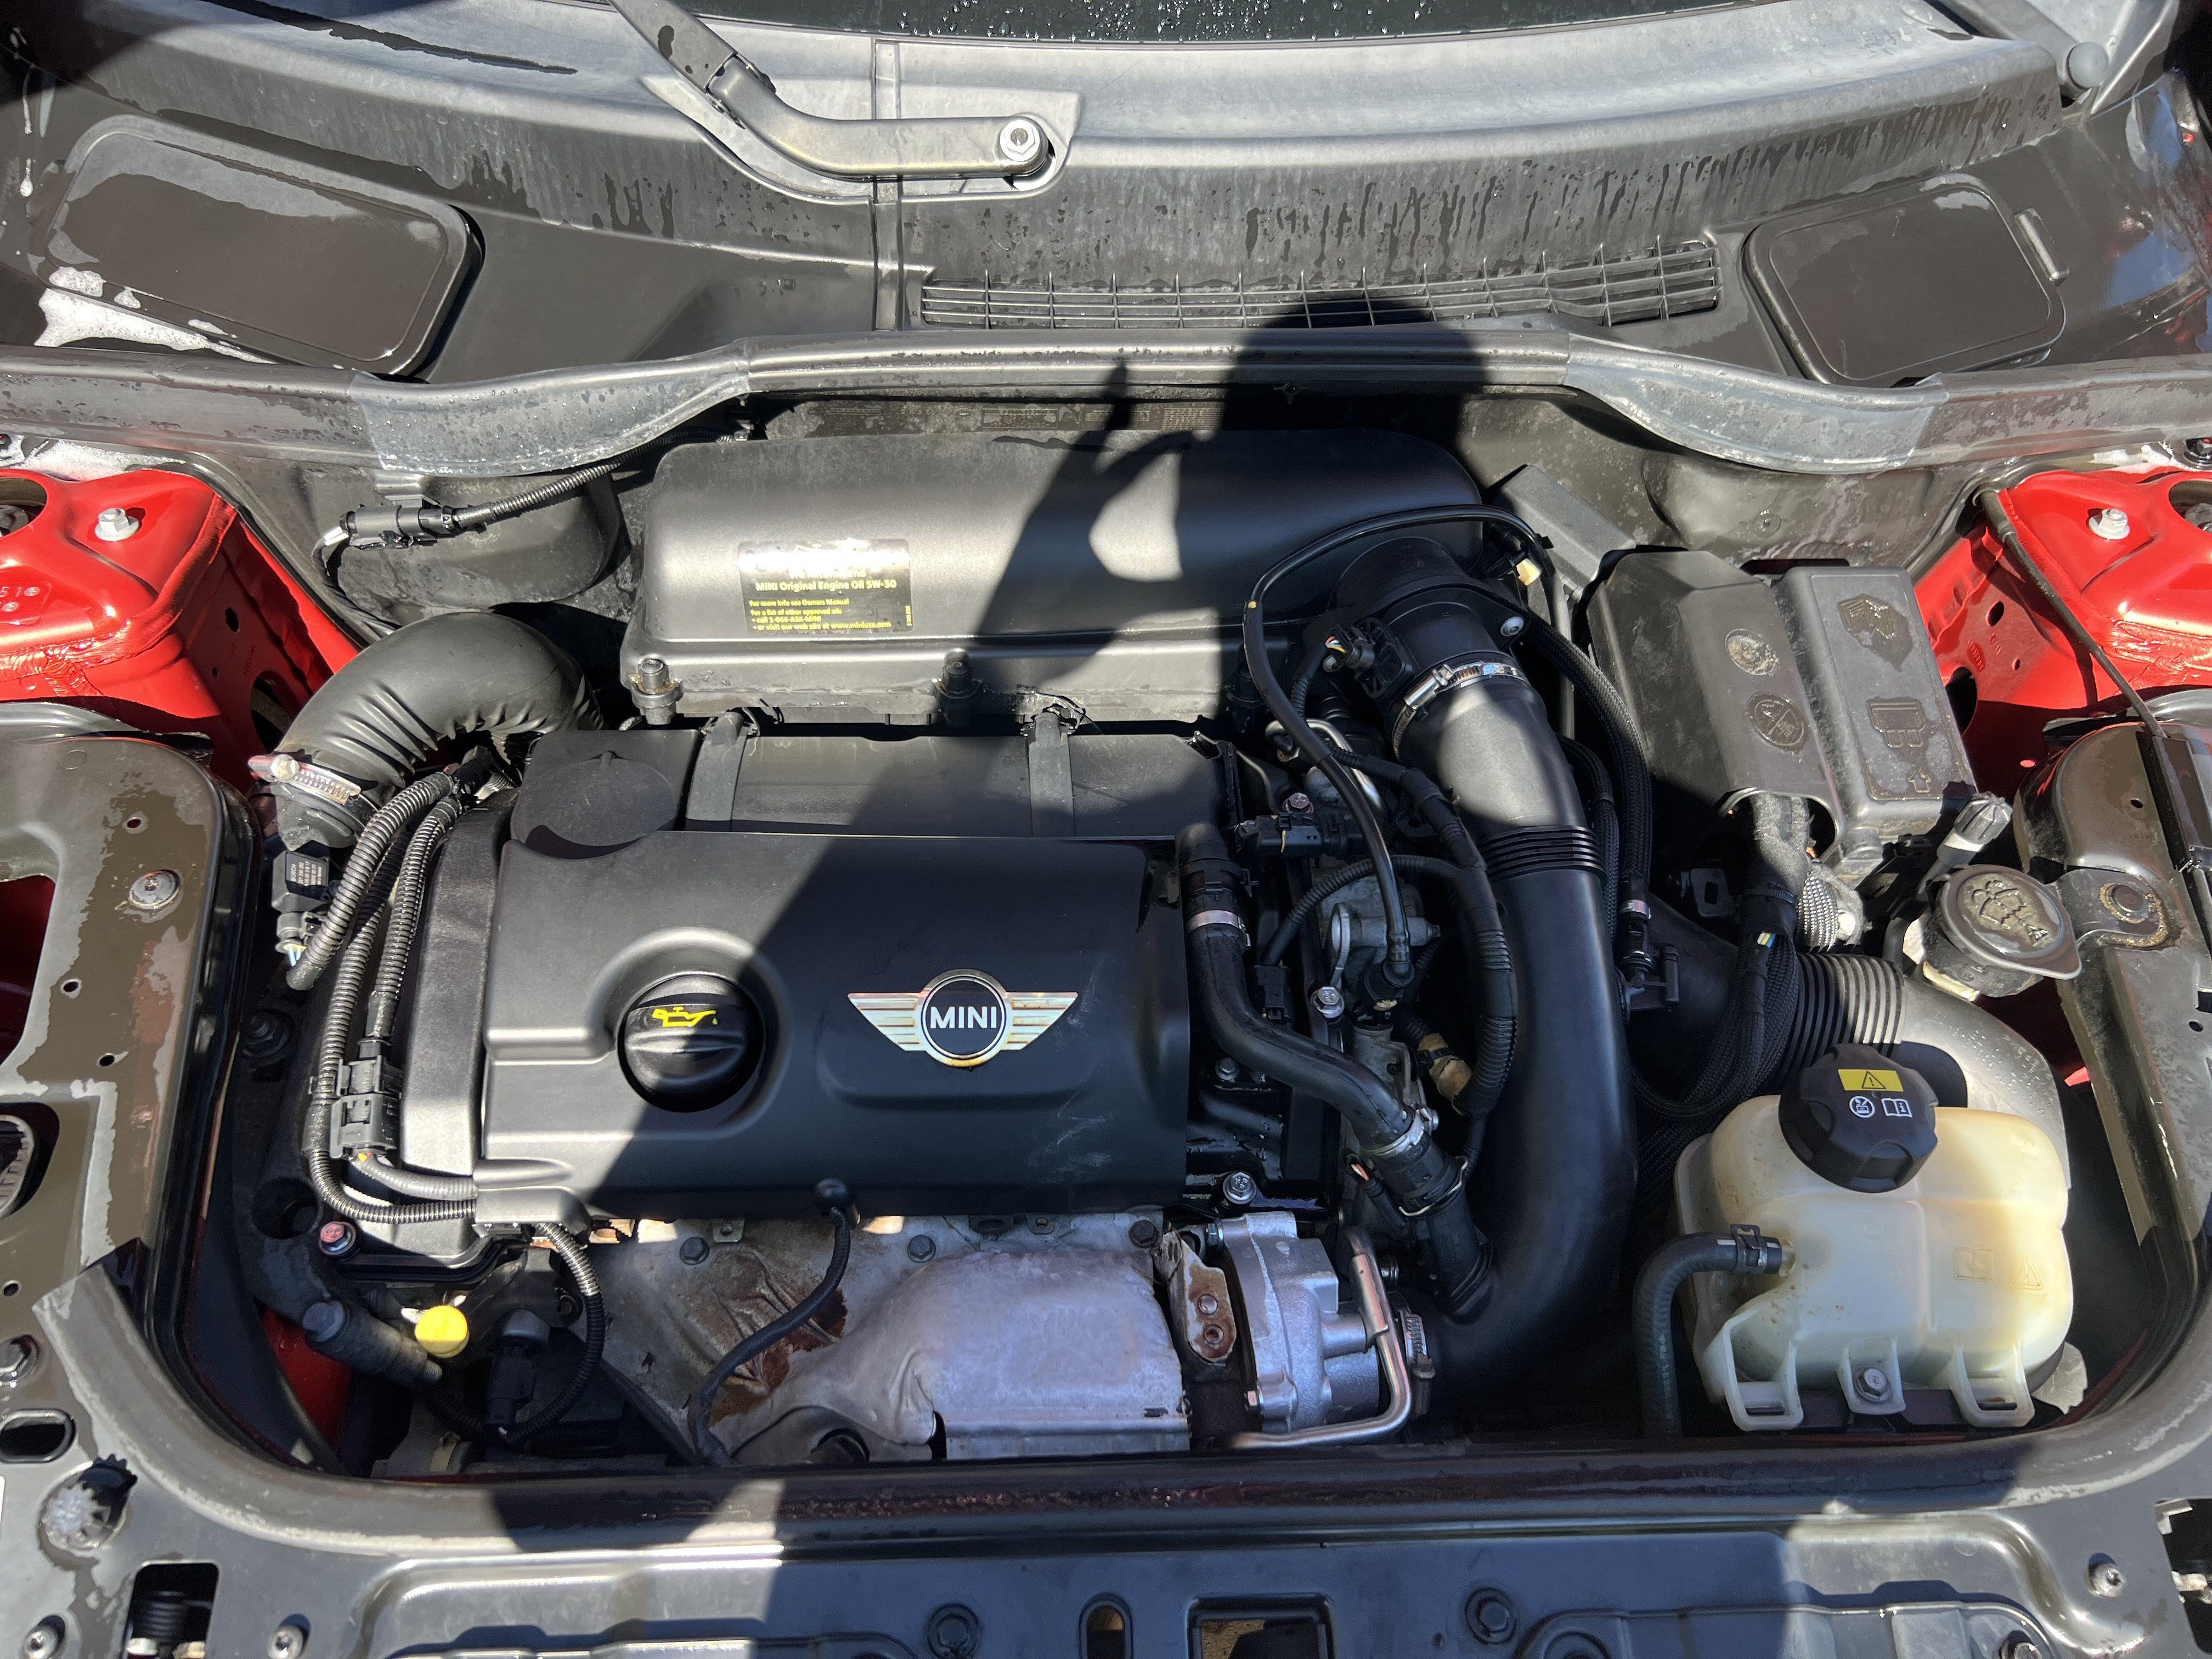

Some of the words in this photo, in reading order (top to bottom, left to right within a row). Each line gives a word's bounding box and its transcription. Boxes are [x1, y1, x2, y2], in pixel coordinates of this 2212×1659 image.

[755, 582, 778, 591] MINI
[779, 581, 816, 592] Original
[818, 580, 850, 591] Engine
[851, 579, 865, 589] Oil
[866, 579, 897, 589] 5W-30
[803, 608, 831, 616] approved
[930, 1006, 997, 1029] MINI
